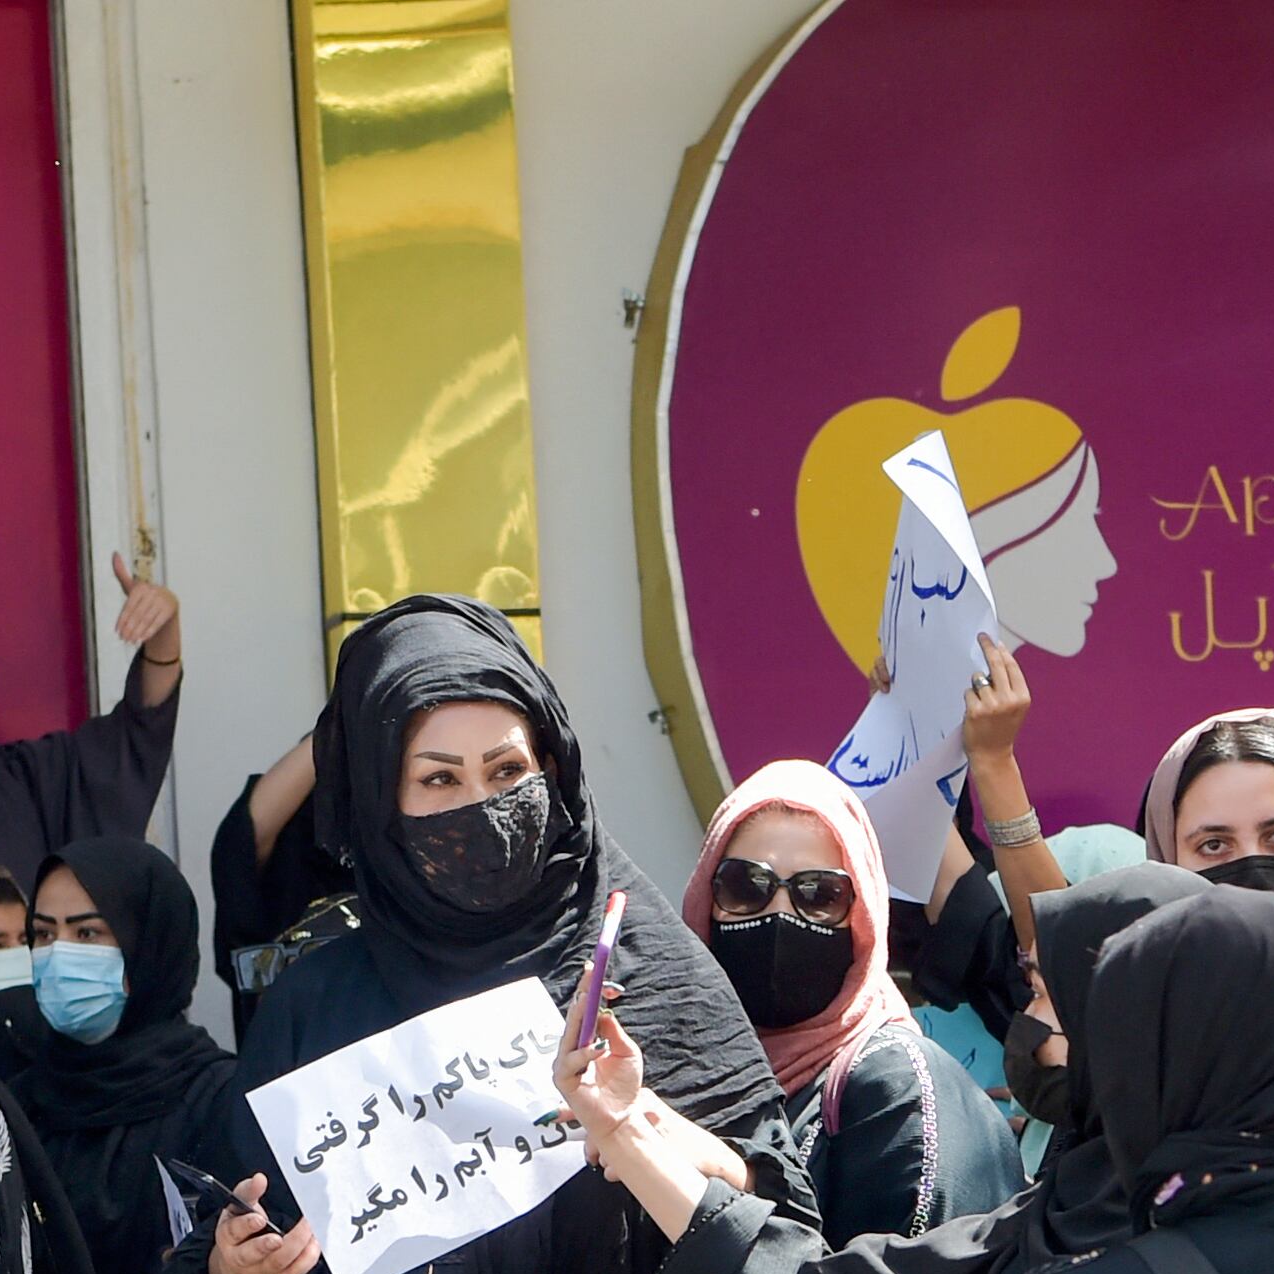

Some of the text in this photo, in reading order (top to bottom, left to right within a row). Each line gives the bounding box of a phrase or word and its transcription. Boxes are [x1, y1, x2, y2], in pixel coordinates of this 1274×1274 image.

[387, 1084, 427, 1122] را
[432, 1051, 497, 1109] پاکم
[293, 1092, 380, 1174] گرفتی
[350, 1126, 532, 1244] و آبم را مگیر
